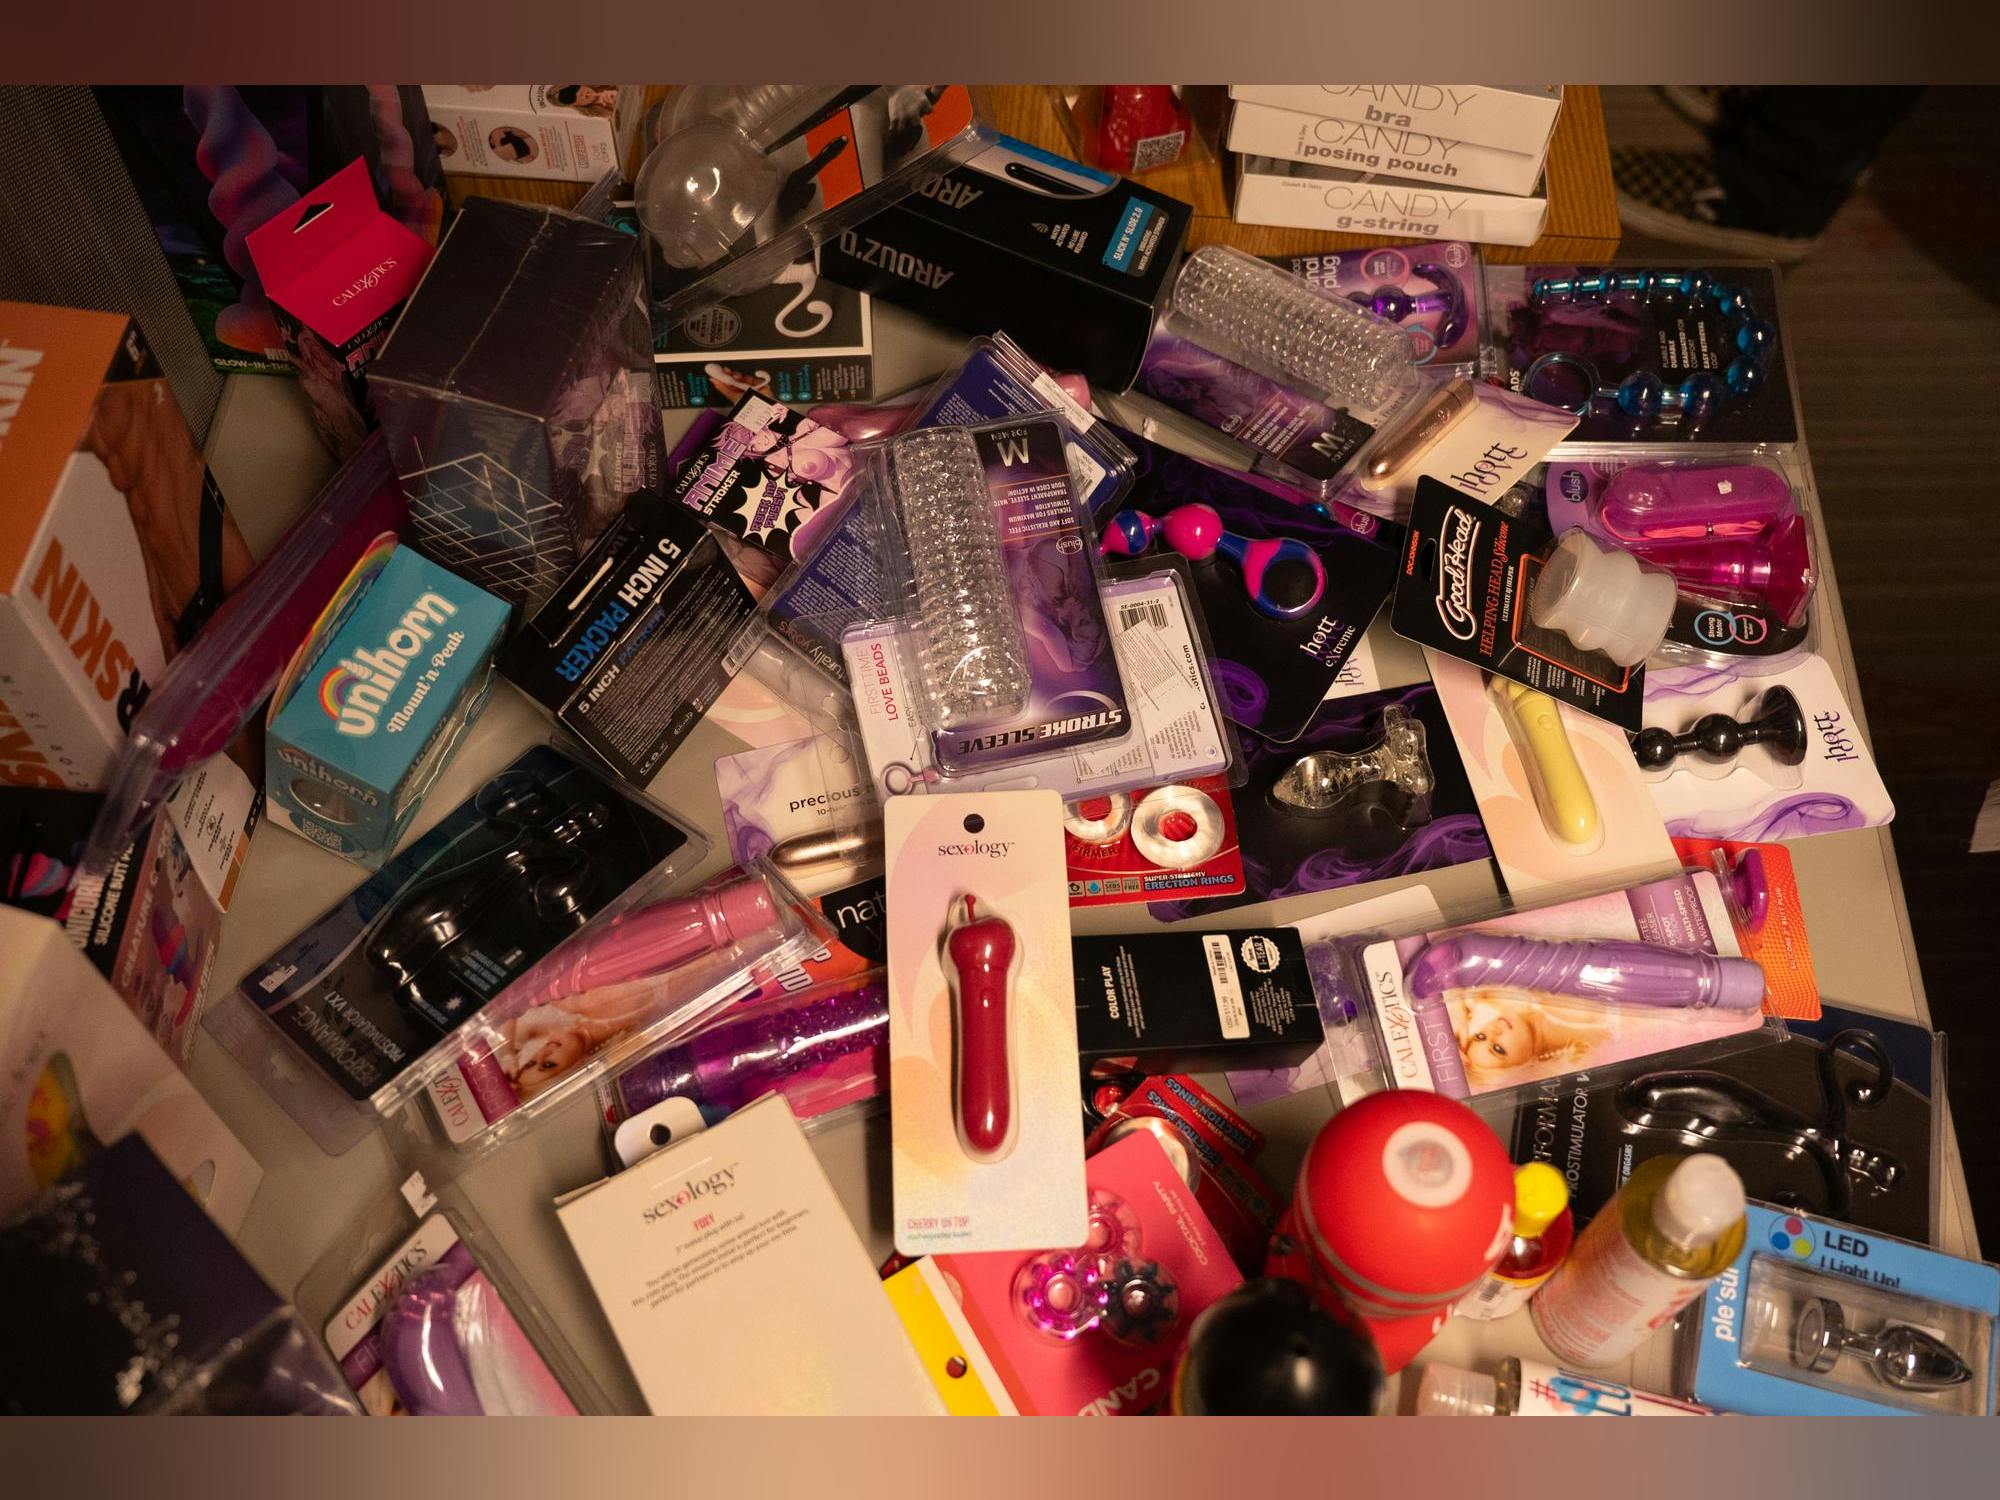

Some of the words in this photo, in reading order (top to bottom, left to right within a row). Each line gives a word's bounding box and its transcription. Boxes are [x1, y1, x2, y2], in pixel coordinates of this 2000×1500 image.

[1364, 104, 1412, 127] bra
[1311, 115, 1460, 162] CANDY
[1303, 142, 1381, 168] posing
[1387, 154, 1459, 177] pouch
[1323, 183, 1469, 222] CANDY
[1112, 240, 1128, 261] SLICK
[1123, 216, 1138, 235] SLIDE
[1337, 213, 1439, 238] g-string
[836, 225, 956, 293] AROUZ'D
[1322, 255, 1341, 288] plug
[1678, 331, 1689, 367] GRADUATED
[1697, 320, 1708, 351] RETRIEVAL
[1668, 340, 1677, 367] DURABLE
[1702, 353, 1710, 368] EASY
[1509, 370, 1520, 394] ADS
[993, 436, 1031, 467] M
[1310, 427, 1345, 458] M
[673, 449, 711, 498] CALEXOTICS
[681, 432, 747, 515] ANIME
[1449, 439, 1511, 494] hott
[702, 468, 741, 517] STROKER
[1006, 486, 1029, 496] ACTION!
[1029, 487, 1067, 500] TRANSPARENT
[1034, 482, 1050, 491] COCK
[1049, 479, 1065, 488] YOUR
[1562, 470, 1580, 502] blush
[763, 485, 789, 531] PUSSY!
[992, 497, 1008, 506] WATC
[1007, 512, 1035, 523] MAXIMUM
[1034, 498, 1069, 510] STIMULATION
[1034, 510, 1045, 518] FOR
[1045, 505, 1072, 516] TICKLERS
[1007, 525, 1021, 534] FEEL
[1021, 520, 1048, 531] REALISTIC
[1048, 518, 1060, 526] AND
[1059, 515, 1074, 525] SOFT
[655, 535, 683, 560] 5
[1055, 538, 1081, 553] blush
[1491, 519, 1510, 562] Silicone
[618, 551, 670, 608] INCH
[1486, 558, 1505, 594] HEAD
[1506, 565, 1515, 587] HELPER
[31, 538, 136, 702] SKIN
[1501, 594, 1512, 622] ULTIMATE
[1298, 611, 1337, 658] hott
[1479, 594, 1500, 655] HELPING
[553, 598, 631, 684] PACKER
[1323, 622, 1357, 670] eXtreme
[337, 591, 458, 737] unihorn
[576, 699, 592, 715] 5
[587, 662, 622, 703] INCH
[616, 604, 670, 666] PACKER
[806, 643, 847, 679] turally
[856, 650, 872, 672] TIME
[870, 643, 890, 684] BEADS
[386, 667, 440, 736] Mount'n
[428, 625, 467, 671] Peak
[861, 673, 881, 714] FIRST
[881, 688, 898, 720] LOVE
[1038, 708, 1123, 739] STROKE
[1812, 711, 1846, 759] hott
[957, 725, 1037, 755] SLEEVE
[789, 785, 860, 812] precious
[938, 840, 1010, 858] sexology
[1144, 871, 1205, 882] SUPER-STRETCHY
[1144, 878, 1198, 890] ERECTION
[1199, 875, 1234, 886] RINGS
[91, 887, 121, 948] SILICONE
[109, 859, 130, 891] BUTT
[1683, 883, 1708, 939] WATERPROOF
[1775, 886, 1784, 906] PLUG
[1660, 913, 1677, 946] G-SPOT
[1672, 888, 1696, 942] MULTI-SPEED
[1100, 964, 1114, 988] PLAY
[1105, 988, 1119, 1018] COLOR
[1375, 969, 1421, 1079] CALEXOTICS
[1423, 1019, 1458, 1083] FIRST
[1144, 1088, 1178, 1121] RINGS
[1163, 1075, 1200, 1107] RINGS
[1622, 1143, 1633, 1175] ORGASMS
[640, 1161, 739, 1227] sexology
[907, 1217, 937, 1229] CHERRY
[953, 1216, 969, 1227] TOP
[1822, 1230, 1870, 1258] LED
[1820, 1256, 1825, 1267] I
[1829, 1258, 1870, 1281] Light
[1872, 1270, 1901, 1288] Up!
